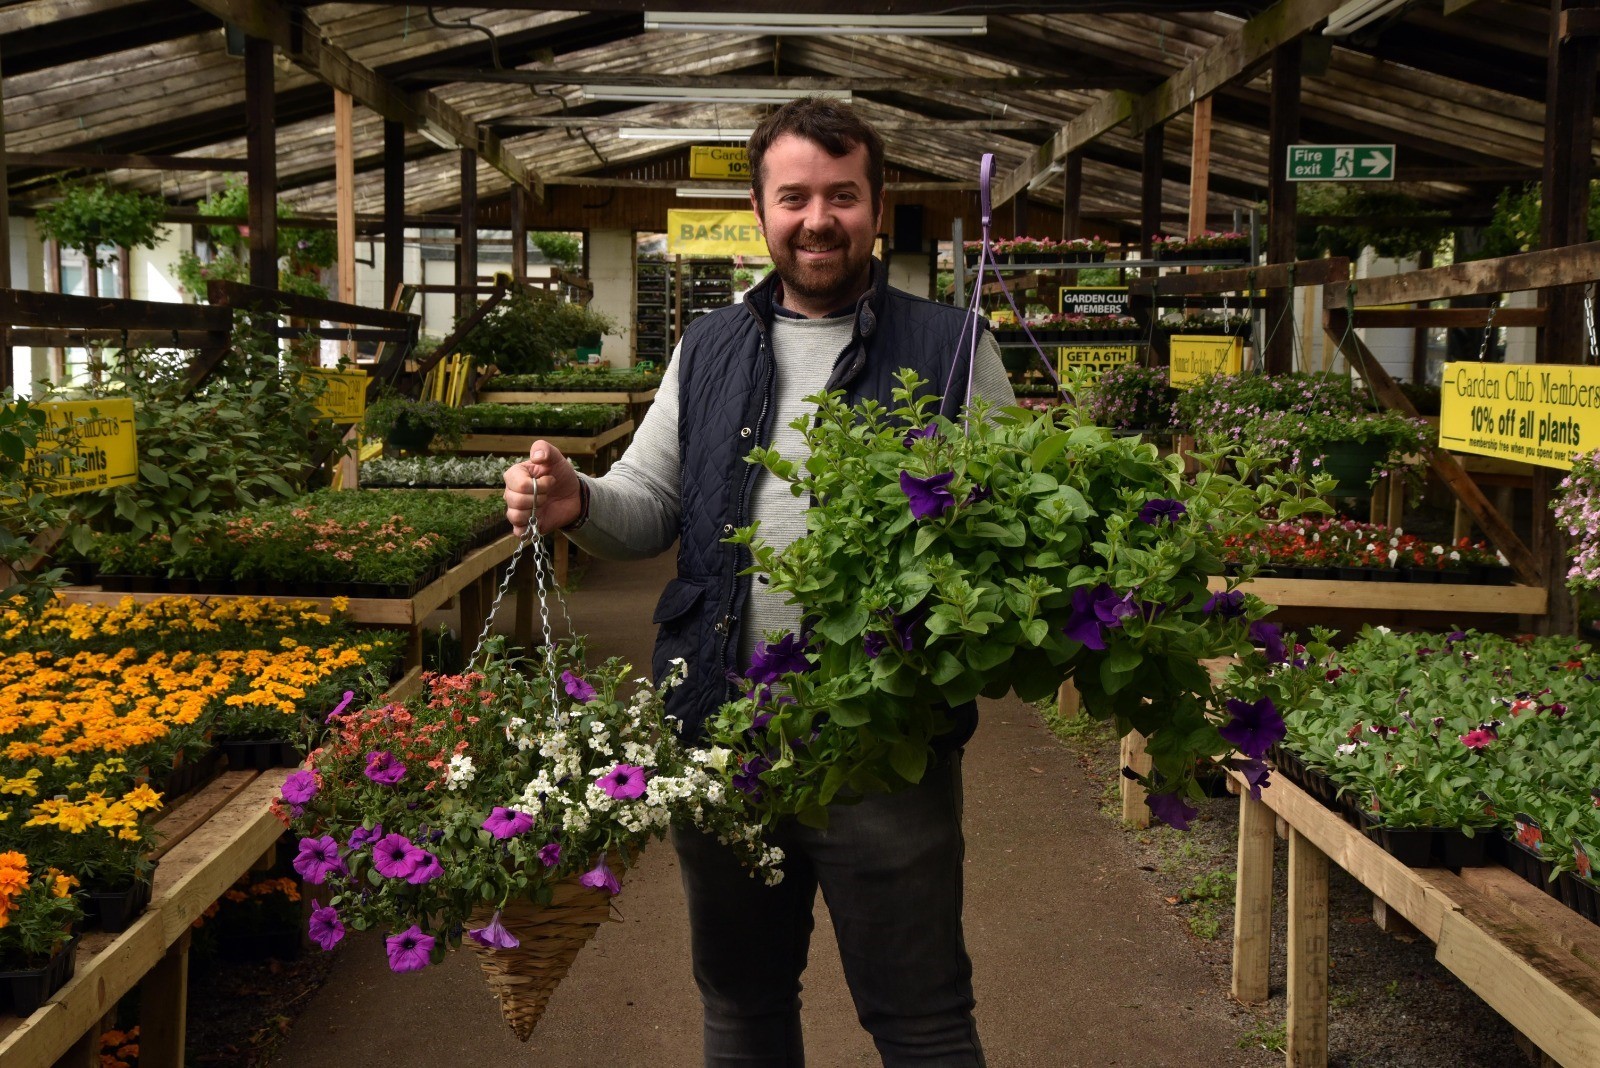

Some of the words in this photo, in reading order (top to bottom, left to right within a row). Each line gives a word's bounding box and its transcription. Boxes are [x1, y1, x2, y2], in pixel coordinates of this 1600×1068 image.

[1295, 150, 1322, 161] Fire
[1295, 163, 1321, 175] exit
[680, 224, 762, 241] BASKET
[1064, 294, 1105, 303] GARDEN
[1074, 304, 1122, 313] MEMBERS
[1067, 352, 1090, 361] GET
[1092, 352, 1100, 361] A
[1104, 351, 1127, 361] 6TH
[1456, 367, 1500, 399] Garden
[1505, 370, 1535, 402] Club
[1540, 370, 1600, 409] Members
[1471, 405, 1495, 434] 10%
[1498, 408, 1516, 436] off
[1519, 411, 1535, 439] all
[1539, 412, 1580, 446] plants
[1469, 437, 1498, 452] membership
[1499, 440, 1509, 453] free
[1511, 442, 1525, 455] when
[1525, 447, 1536, 457] you
[1536, 448, 1553, 459] spend
[1554, 451, 1566, 461] over
